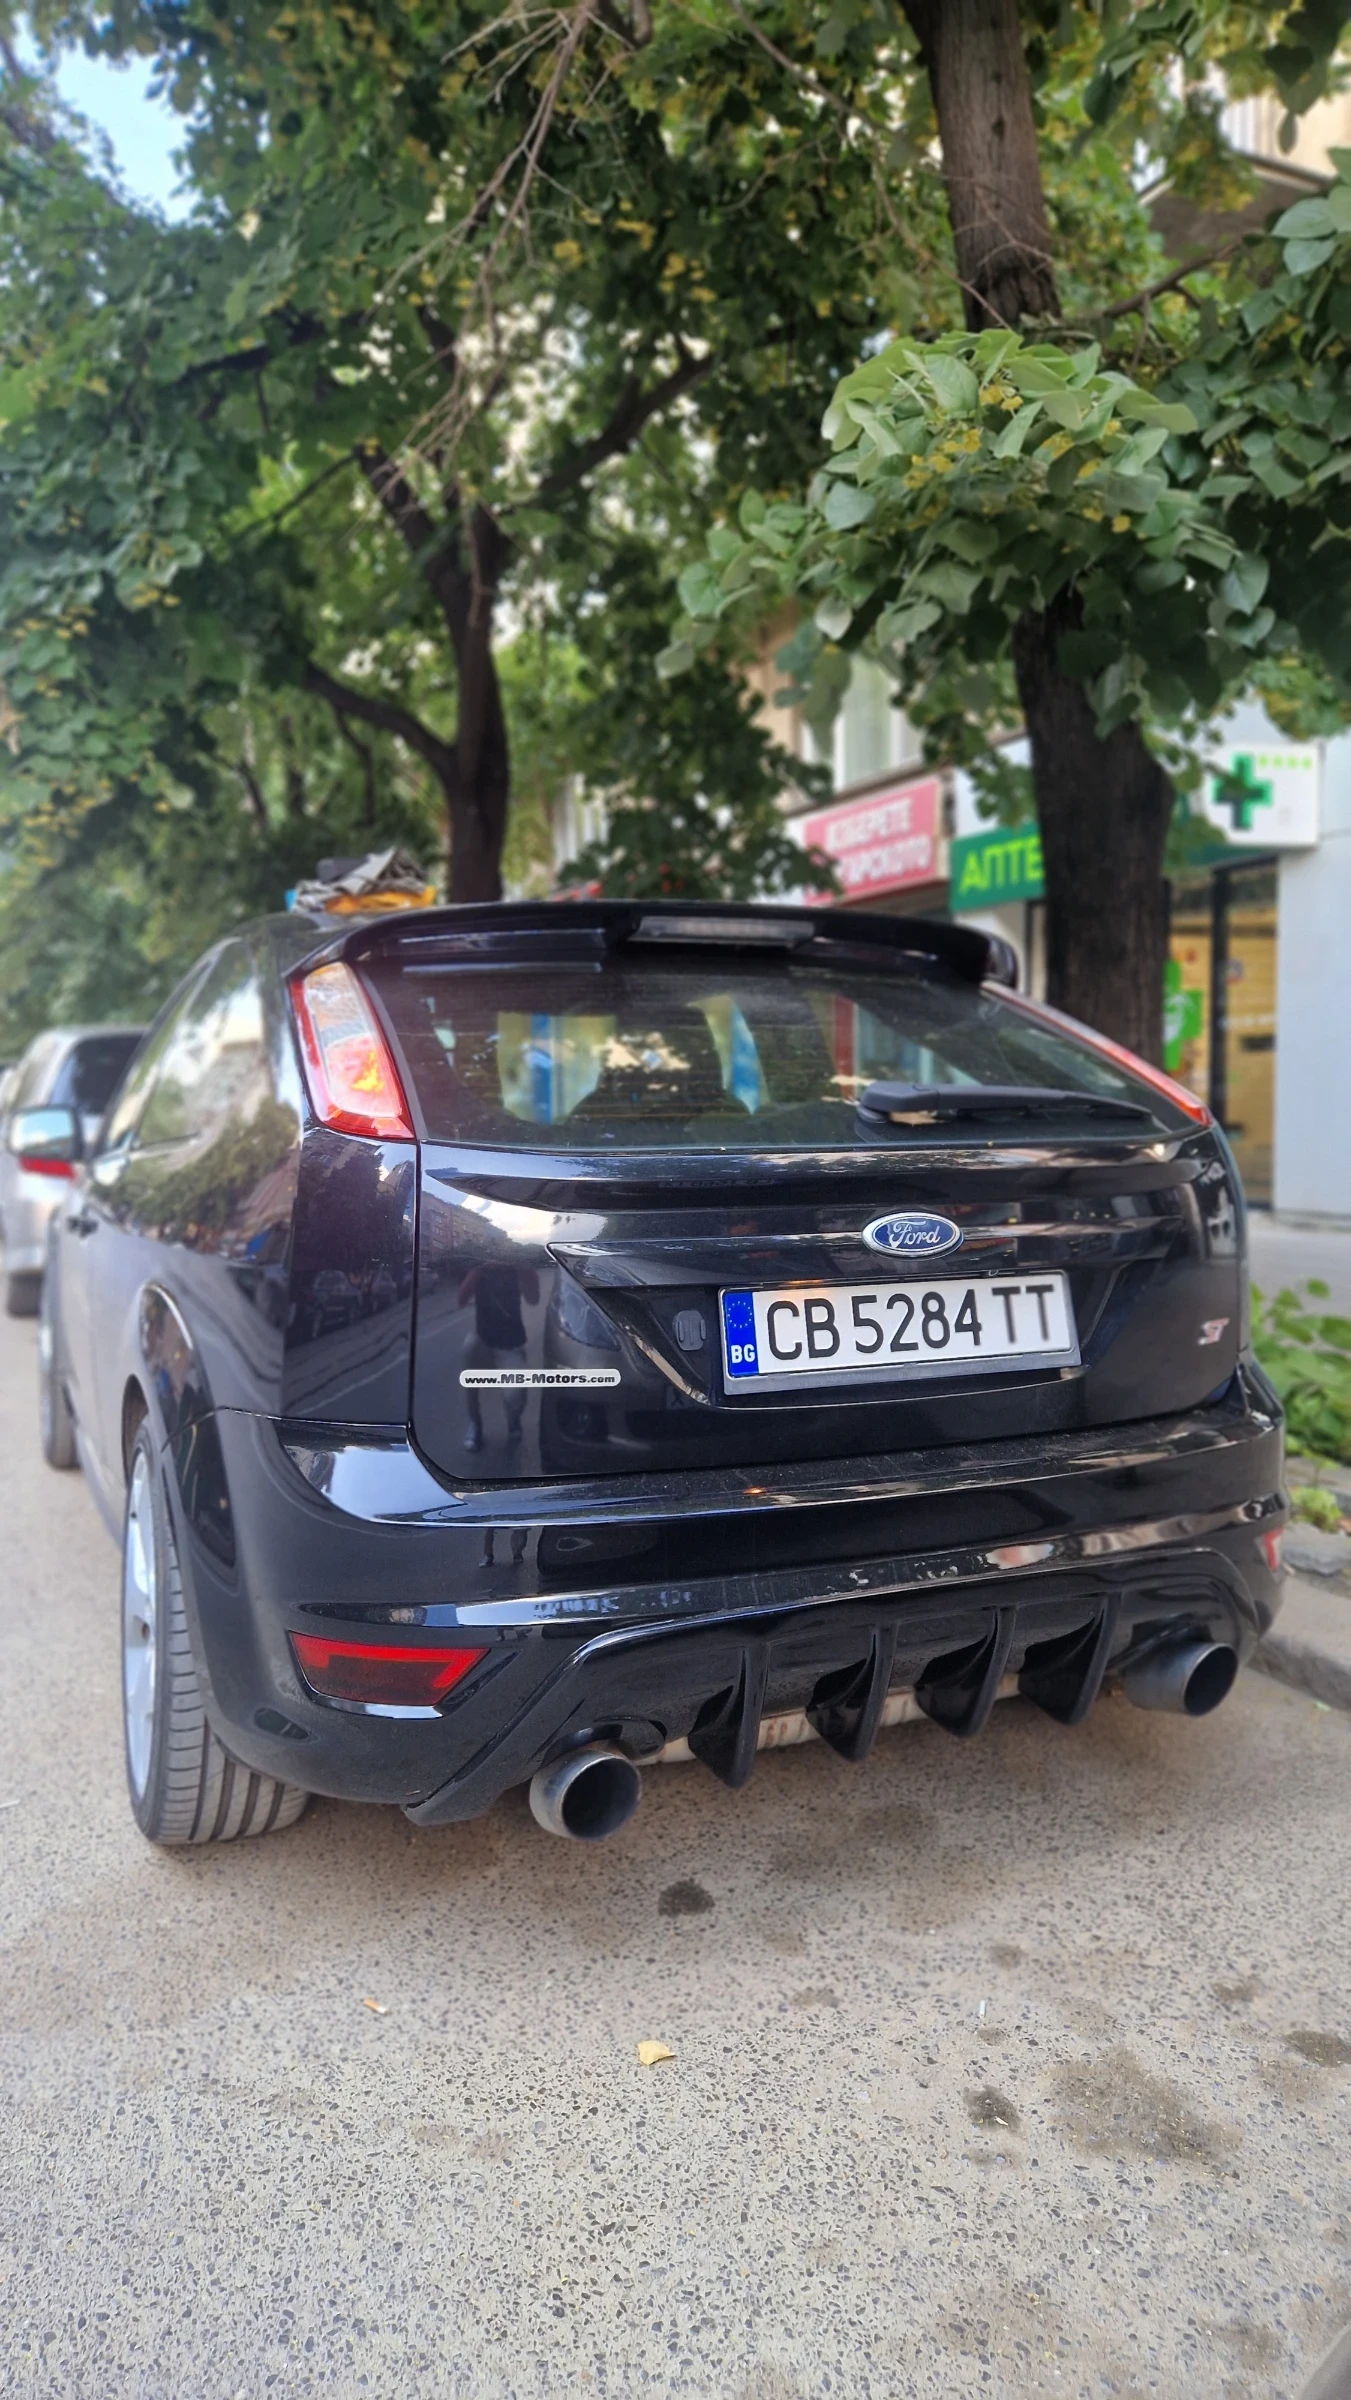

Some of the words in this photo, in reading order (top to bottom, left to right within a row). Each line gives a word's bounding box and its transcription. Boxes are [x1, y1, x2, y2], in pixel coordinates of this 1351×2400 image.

[890, 1220, 941, 1246] Ford
[767, 1297, 840, 1361] CB
[850, 1288, 983, 1354] 5284
[991, 1283, 1055, 1345] TT
[731, 1344, 756, 1364] BG
[464, 1372, 616, 1385] www.MB-Motors.com
